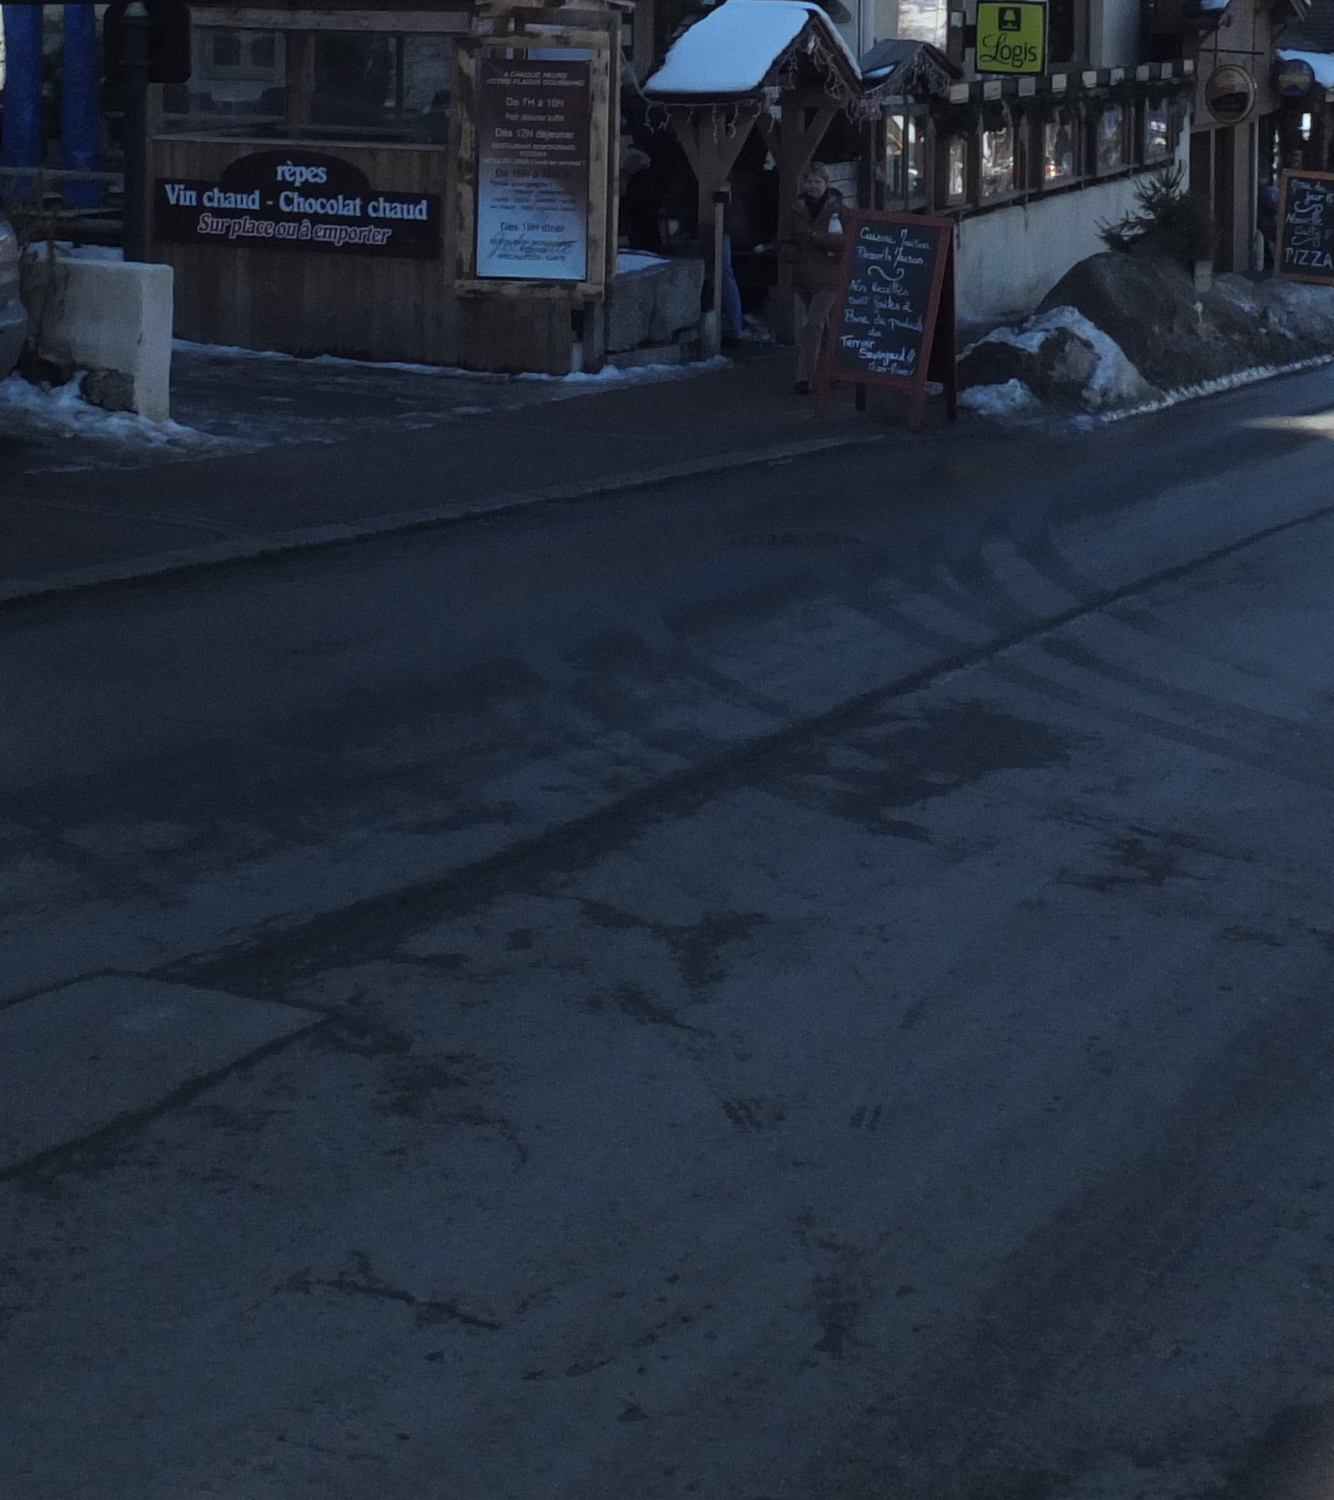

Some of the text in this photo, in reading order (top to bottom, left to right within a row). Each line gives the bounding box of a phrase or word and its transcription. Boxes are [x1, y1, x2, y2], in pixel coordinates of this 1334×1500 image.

[980, 32, 1037, 68] Logis
[276, 160, 328, 187] rèpes
[165, 183, 197, 206] Vin
[202, 187, 261, 211] chaud
[279, 190, 362, 217] Chocolat
[367, 195, 428, 221] chaud
[197, 213, 392, 247] Sur place ou à emporter
[1284, 247, 1334, 270] PIZZA
